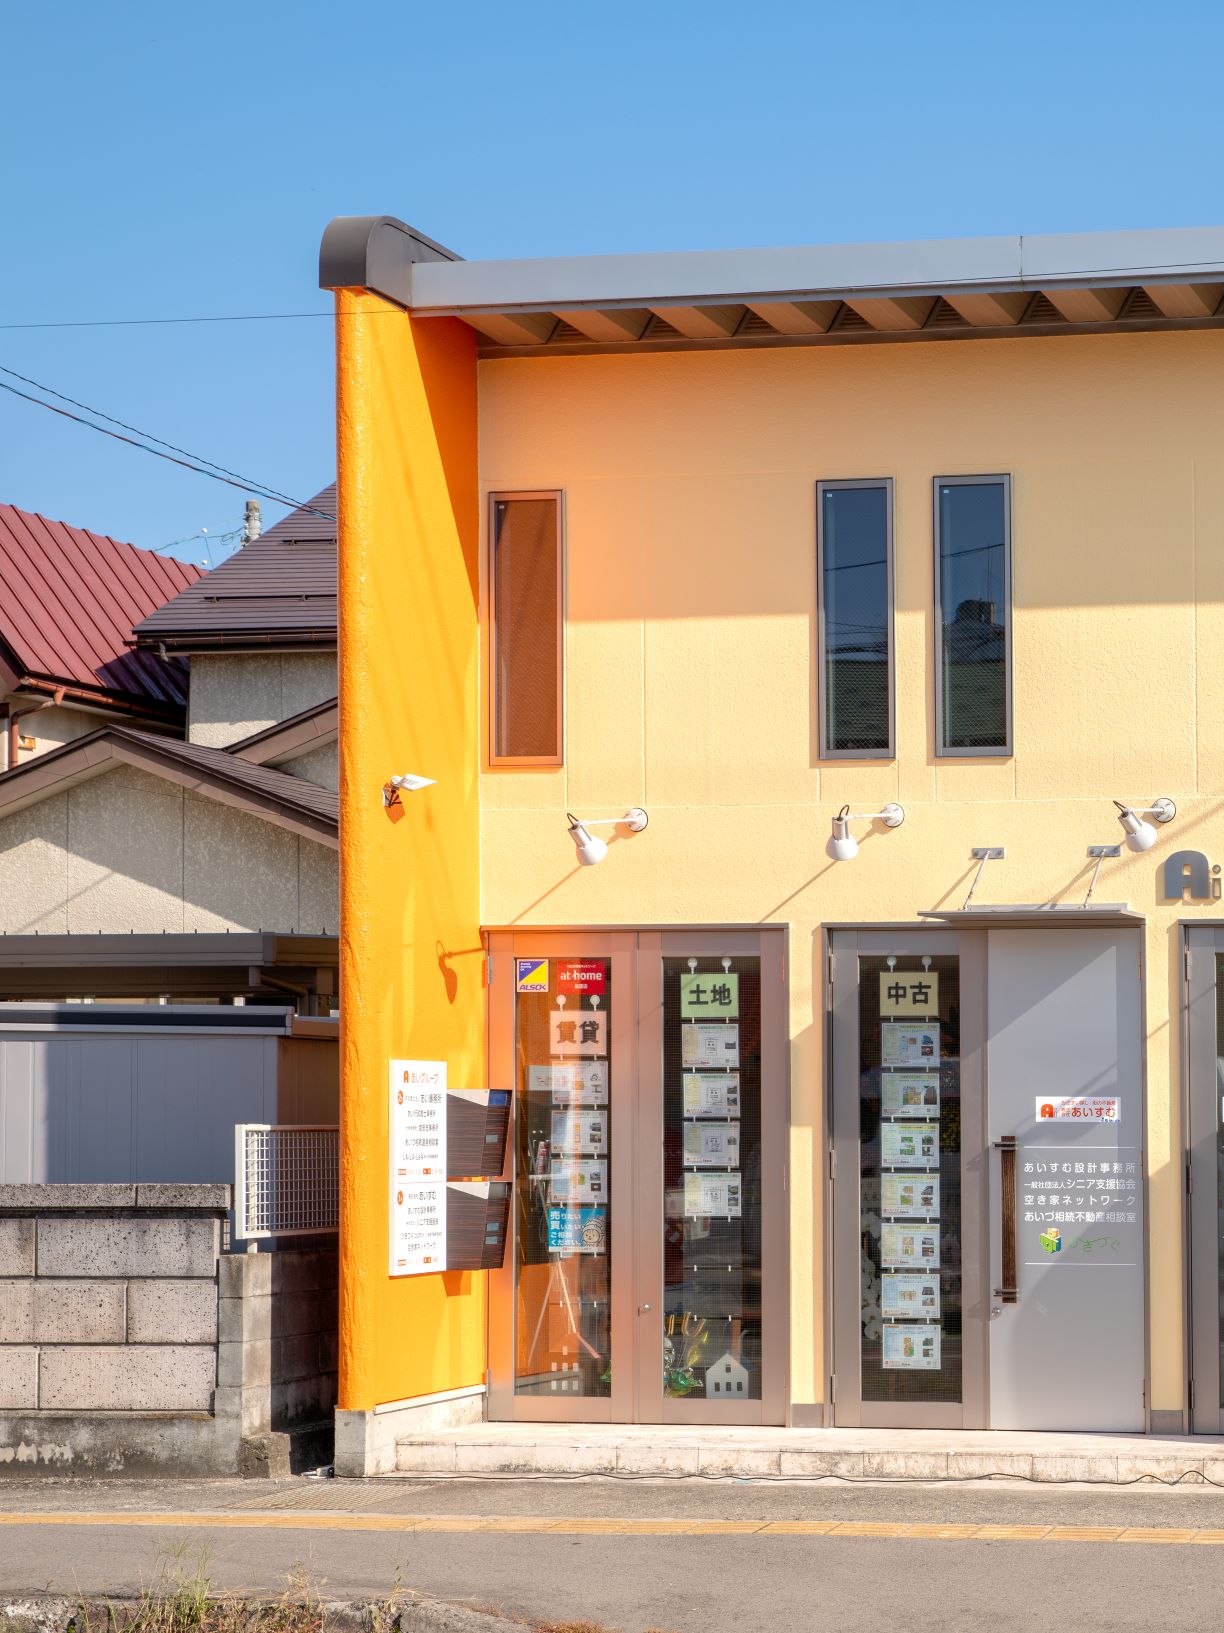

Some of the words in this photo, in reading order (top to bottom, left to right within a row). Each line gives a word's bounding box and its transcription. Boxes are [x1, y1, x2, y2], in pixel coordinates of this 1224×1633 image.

[688, 983, 732, 1006] 土地
[887, 982, 932, 1005] 中古
[556, 1020, 600, 1044] 賃貸
[1071, 1107, 1116, 1118] あいすむ
[1024, 1162, 1136, 1174] あいすむ設計事務所
[1024, 1195, 1136, 1206] 空き家ネットワーク
[1024, 1211, 1137, 1223] あいづ相続不動産相談室
